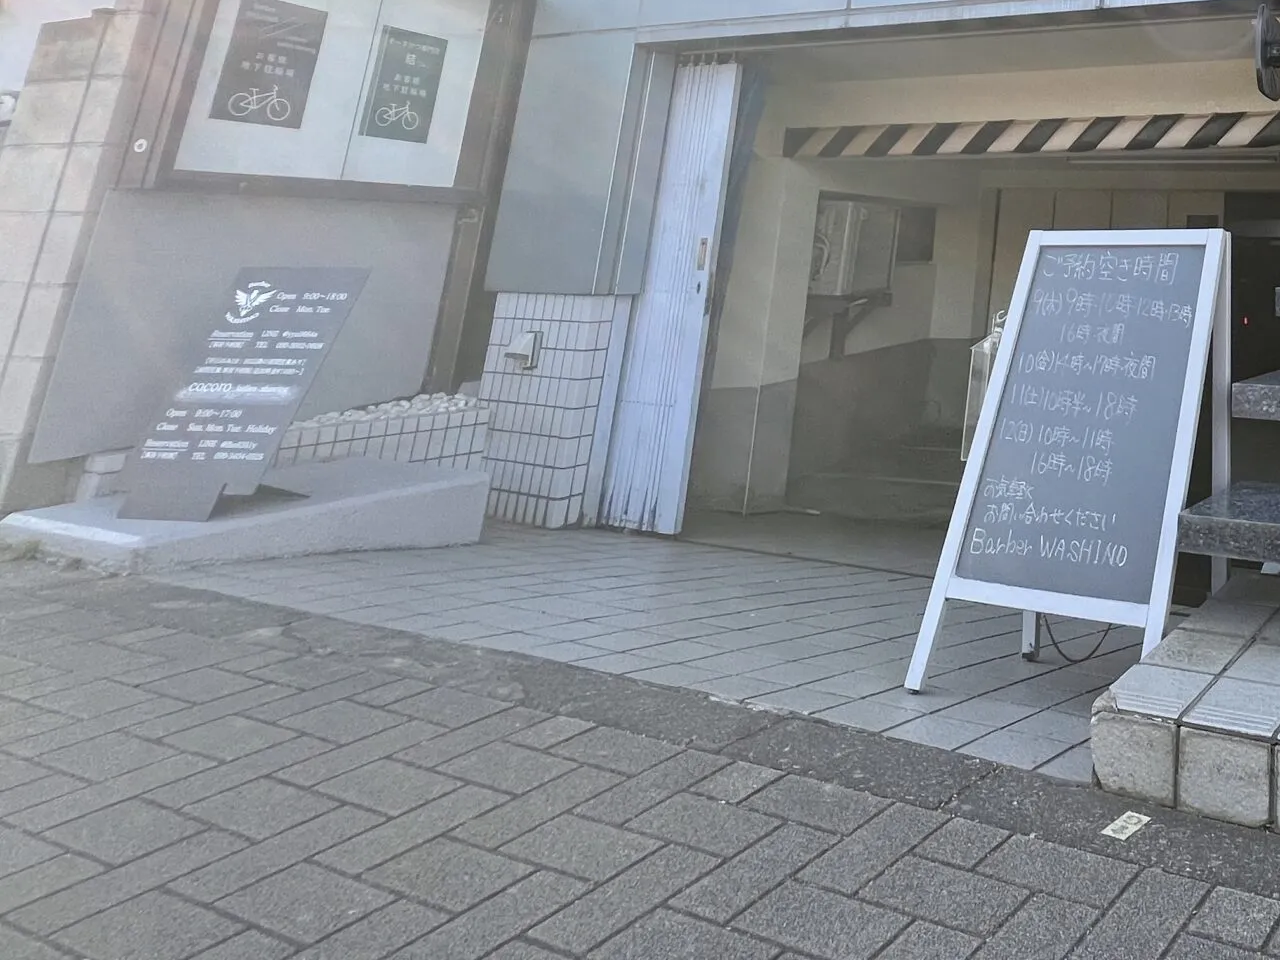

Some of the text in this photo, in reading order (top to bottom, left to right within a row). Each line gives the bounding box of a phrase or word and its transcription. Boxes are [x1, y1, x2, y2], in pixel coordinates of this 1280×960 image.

[1043, 251, 1178, 285] ご予約空き時間
[188, 382, 232, 392] cocoro
[970, 527, 1128, 568] Barber WASHINO
